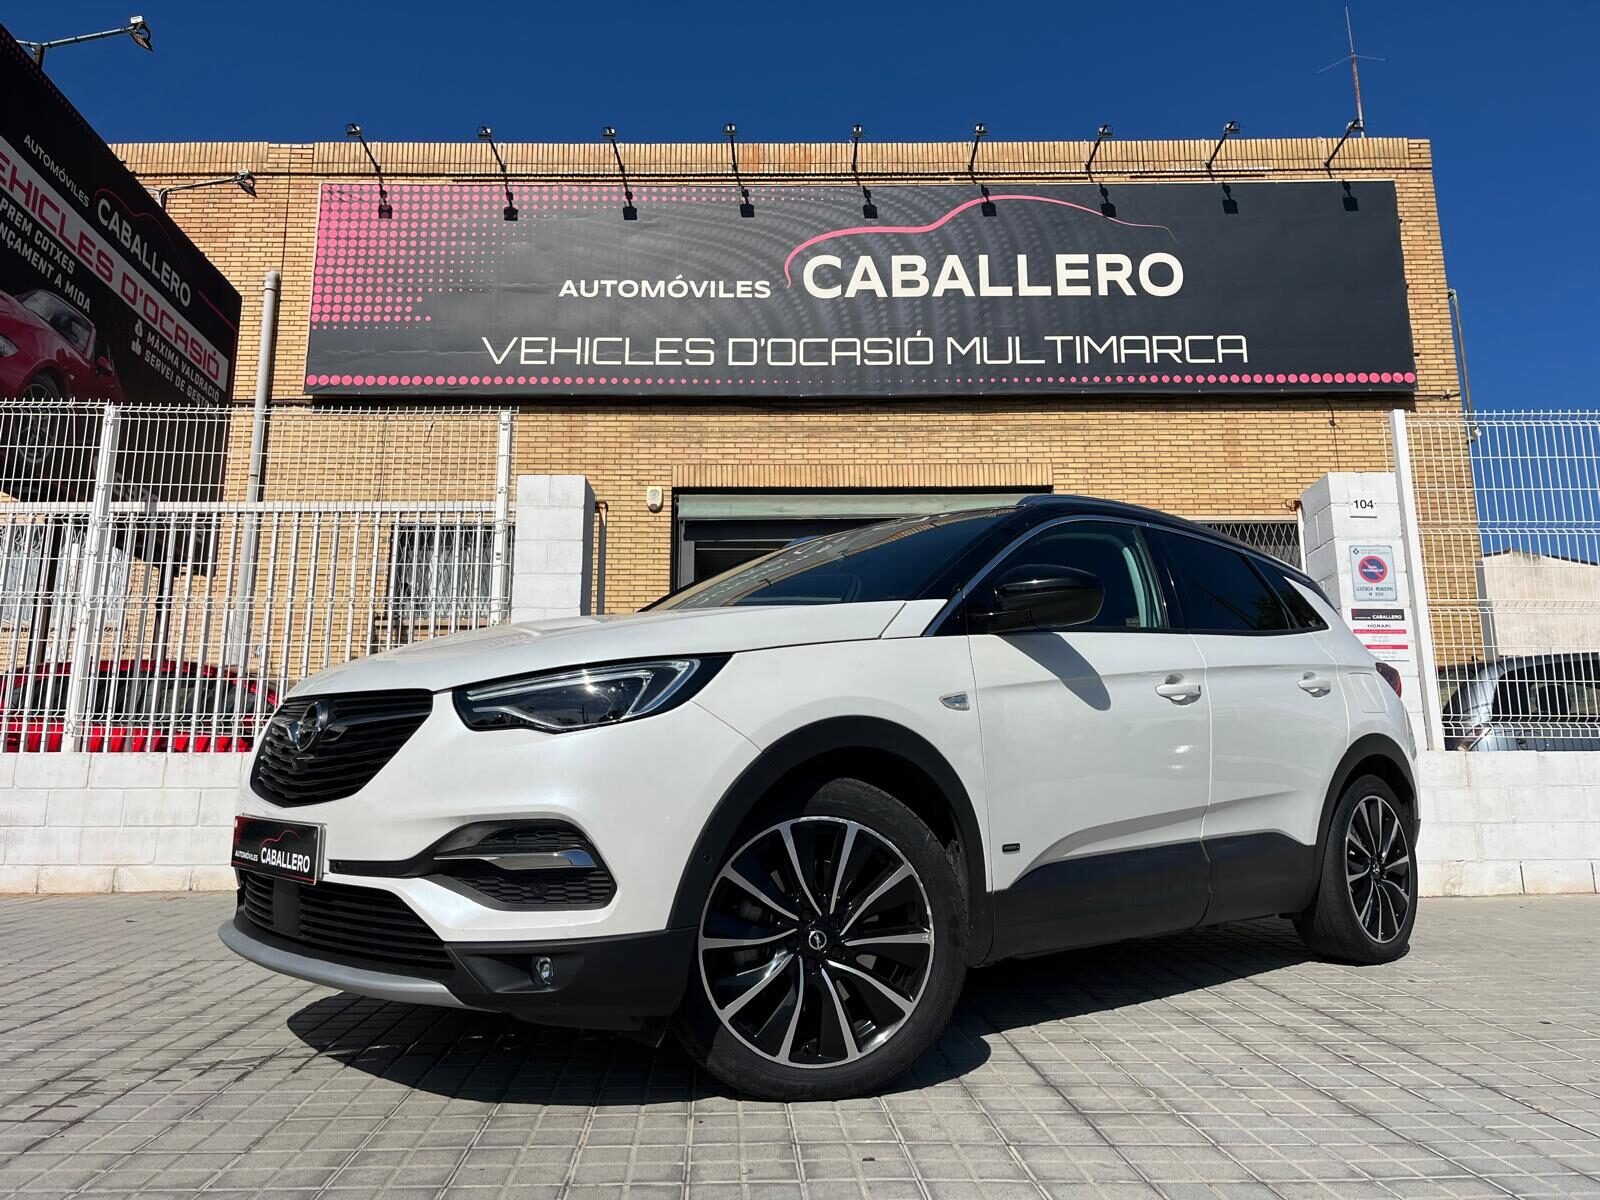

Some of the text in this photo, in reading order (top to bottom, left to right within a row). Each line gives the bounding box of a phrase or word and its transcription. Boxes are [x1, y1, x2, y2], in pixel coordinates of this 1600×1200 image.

[0, 197, 76, 275] PREM COTXES
[24, 135, 191, 308] AUTOMÓVILES CABALLERO
[0, 151, 220, 381] EHICLES D'OCASIÓ
[0, 222, 91, 313] NÇAMENT A MIDA
[558, 252, 1184, 299] AUTOMÓVILES CABALLERO
[144, 349, 174, 382] SERVEI
[174, 375, 186, 392] DE
[481, 330, 1248, 366] VEHICLES D'OCASIÓ MULTIMARCA
[181, 361, 220, 403] VALORACIÓ
[1353, 500, 1374, 509] 104
[234, 847, 310, 873] AUTOMÓVILES CABALLERO
